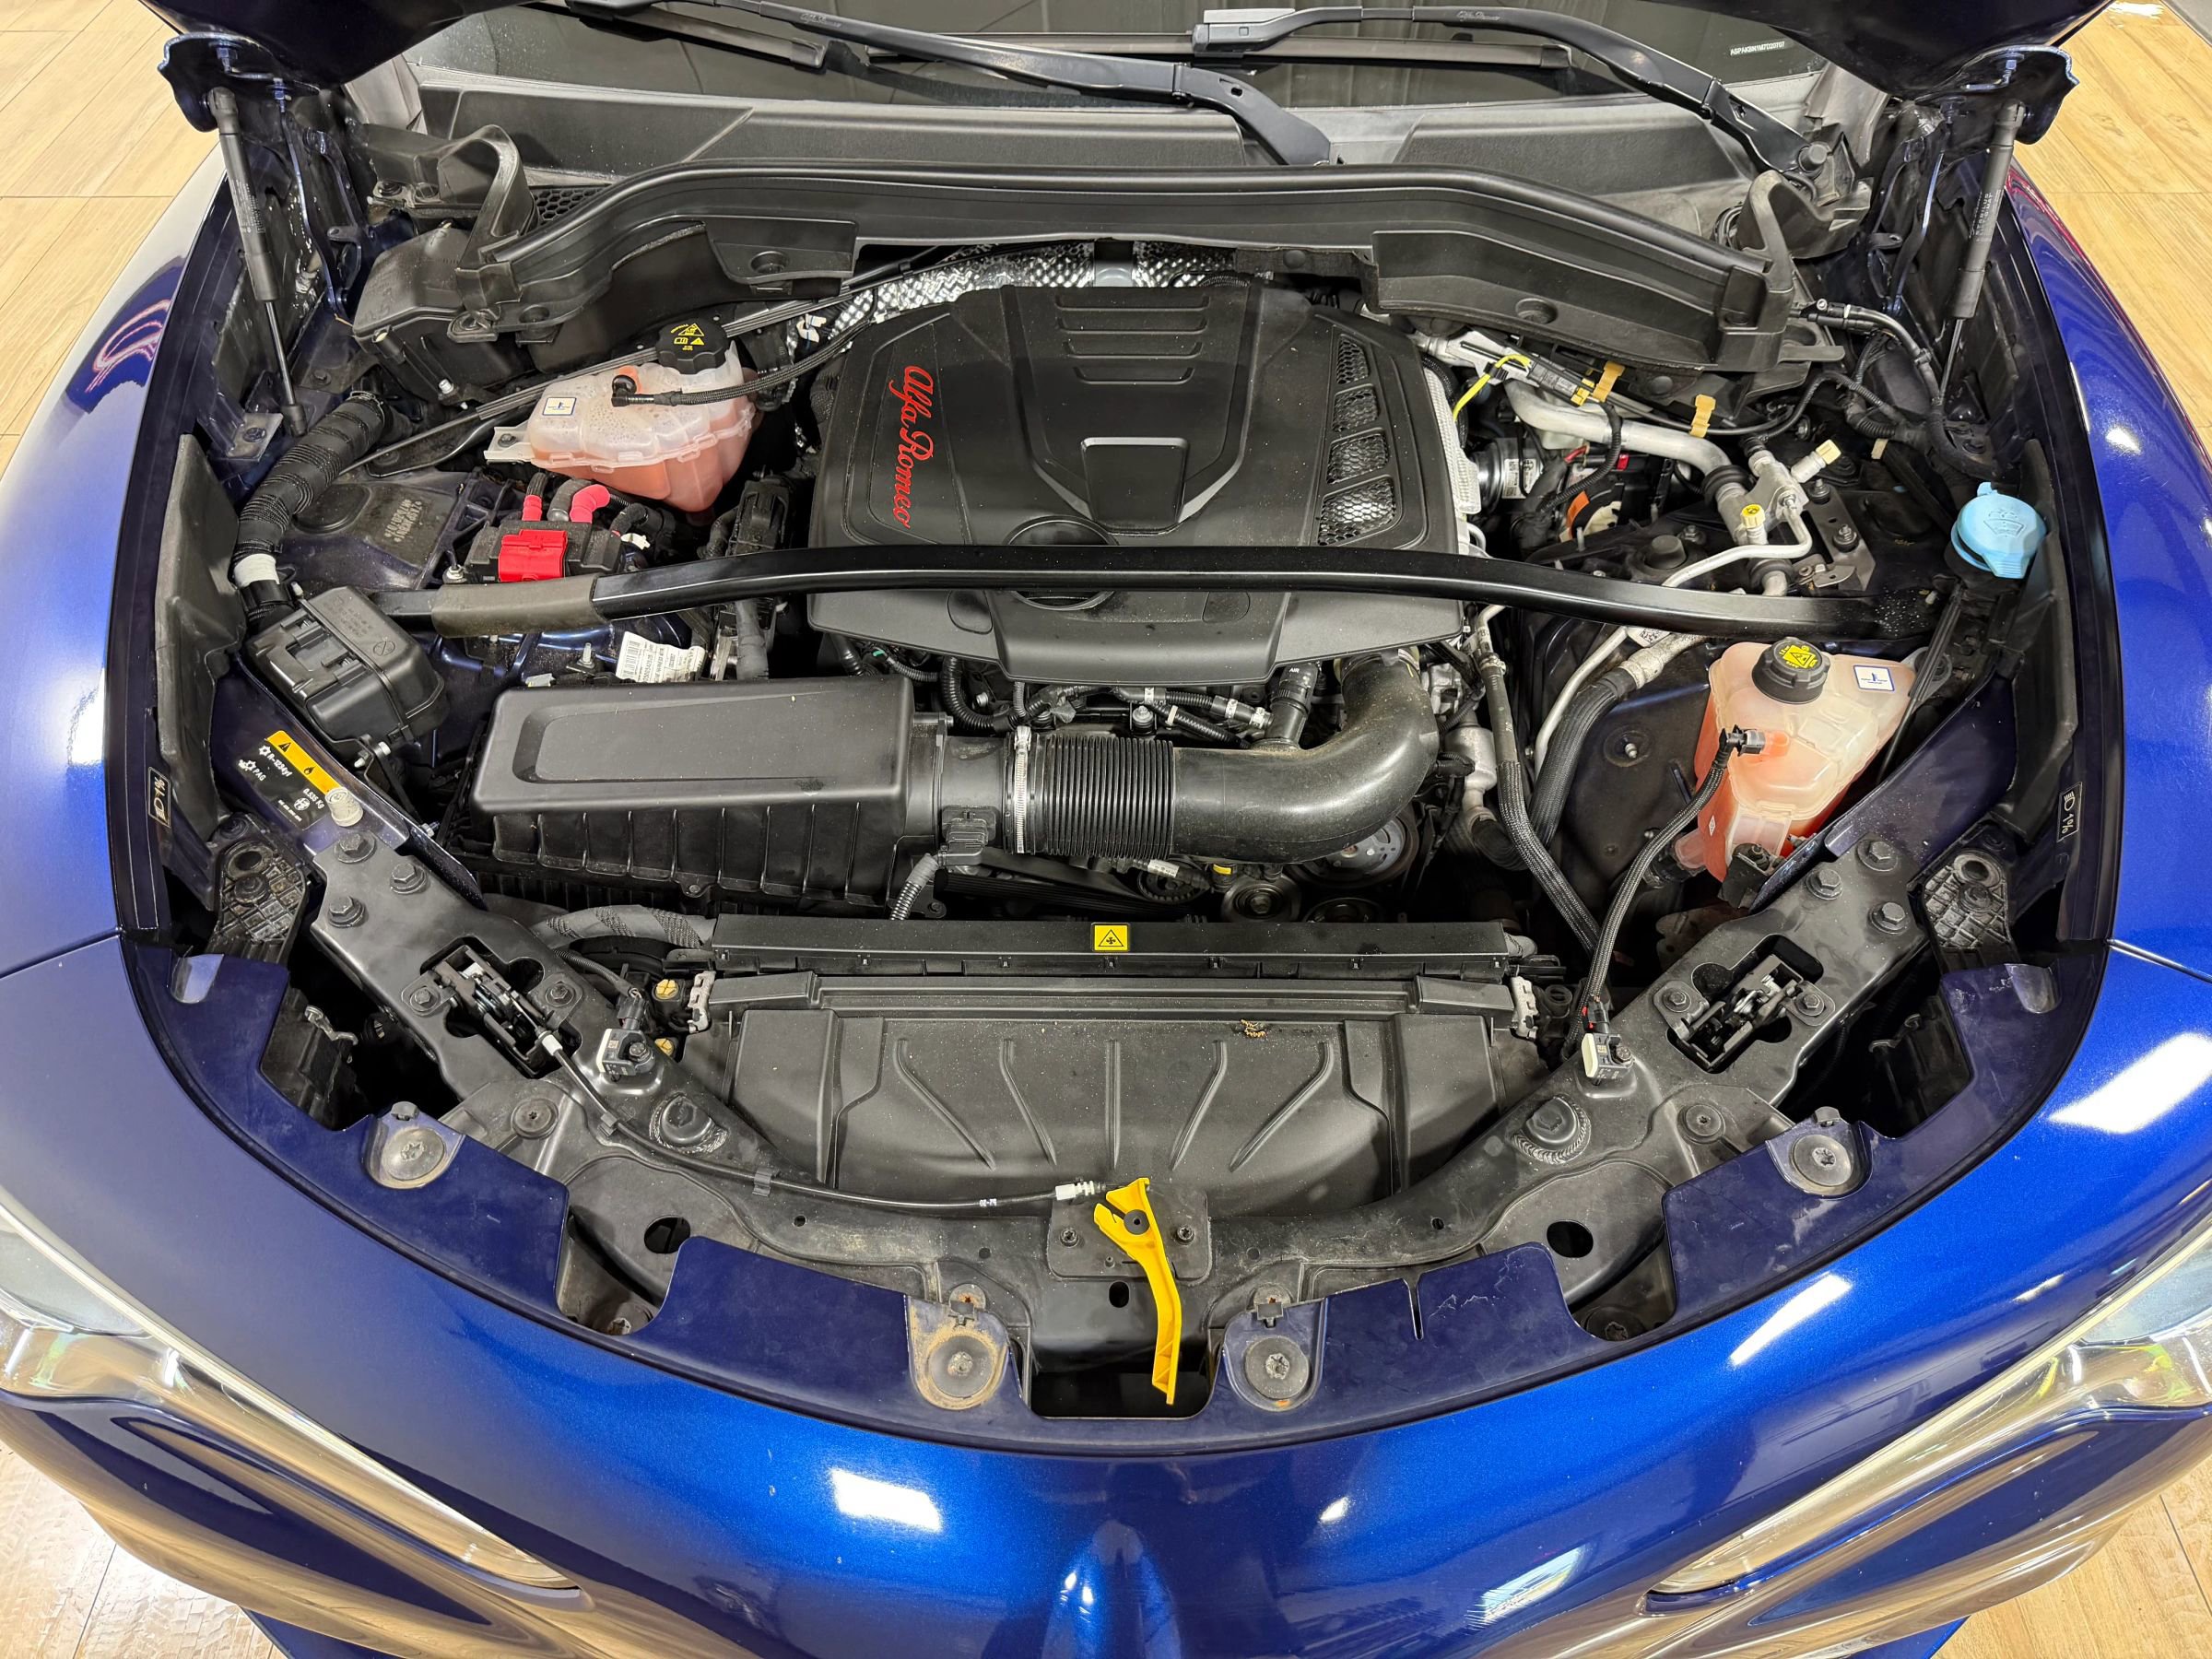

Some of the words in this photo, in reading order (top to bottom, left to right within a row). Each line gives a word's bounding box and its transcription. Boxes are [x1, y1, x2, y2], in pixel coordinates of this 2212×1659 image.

[888, 365, 934, 429] Alfa
[893, 427, 935, 529] Romeo
[252, 768, 266, 782] PAG
[266, 753, 293, 777] R-1234yf
[315, 799, 325, 809] Kg
[2061, 813, 2074, 834] 1%
